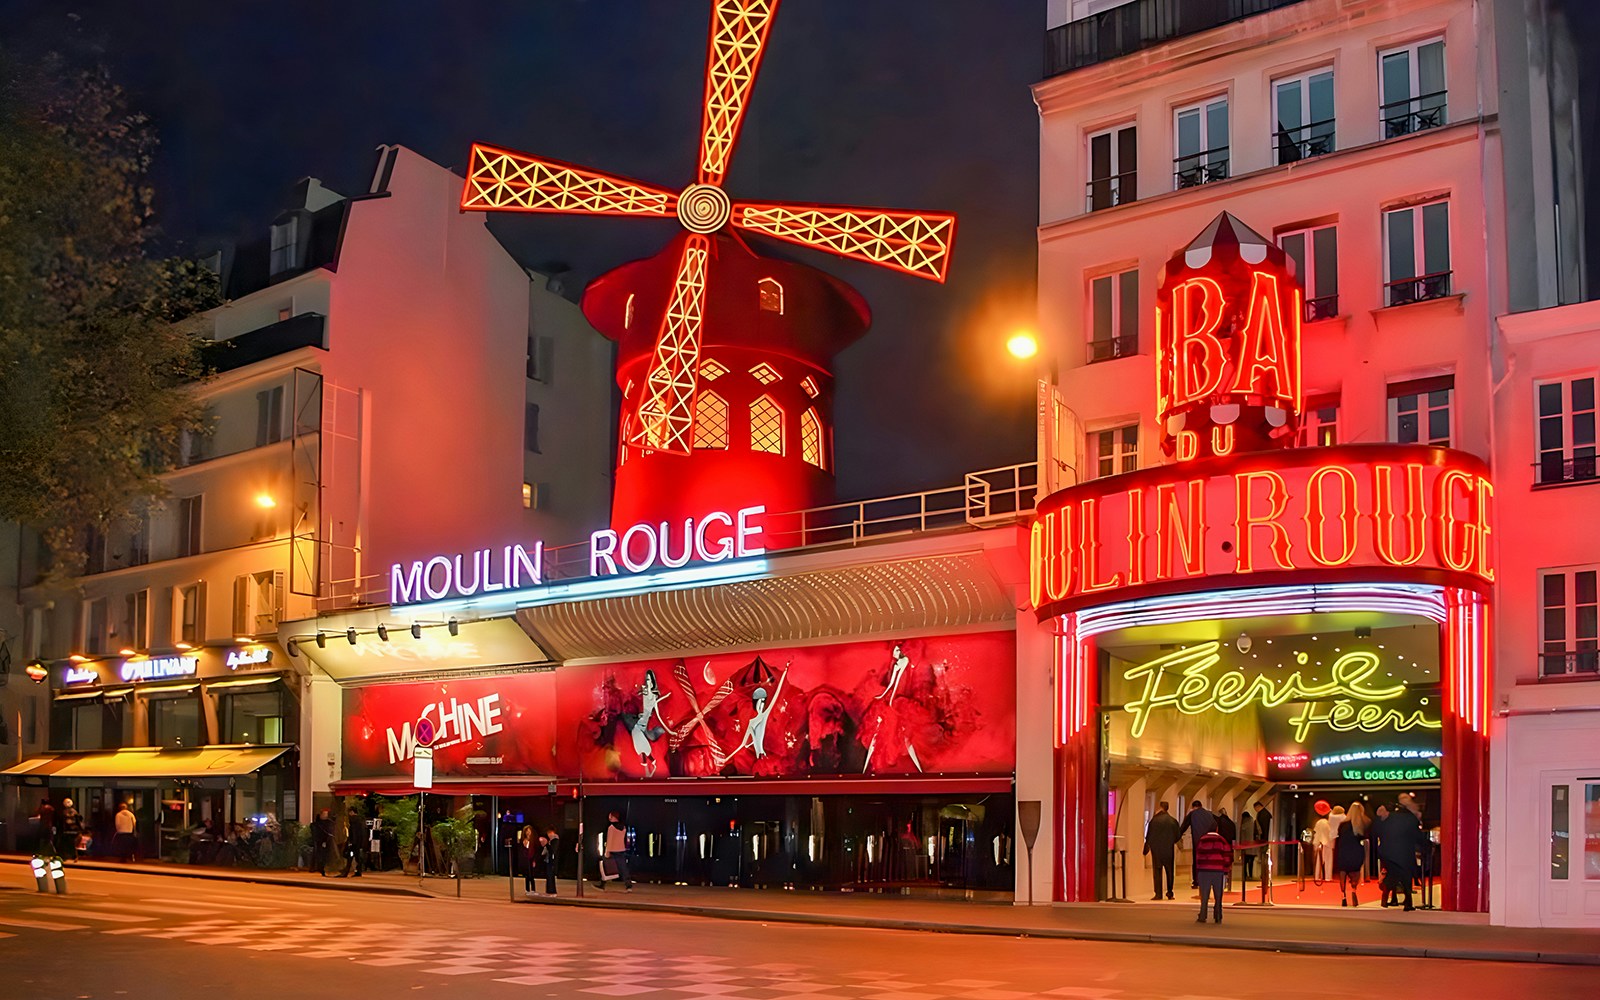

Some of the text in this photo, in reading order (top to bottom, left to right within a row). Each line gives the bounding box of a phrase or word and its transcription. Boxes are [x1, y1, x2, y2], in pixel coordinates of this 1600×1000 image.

[1176, 425, 1234, 460] DU
[391, 505, 767, 604] MOULIN ROUGE
[1235, 464, 1495, 583] ROUGE
